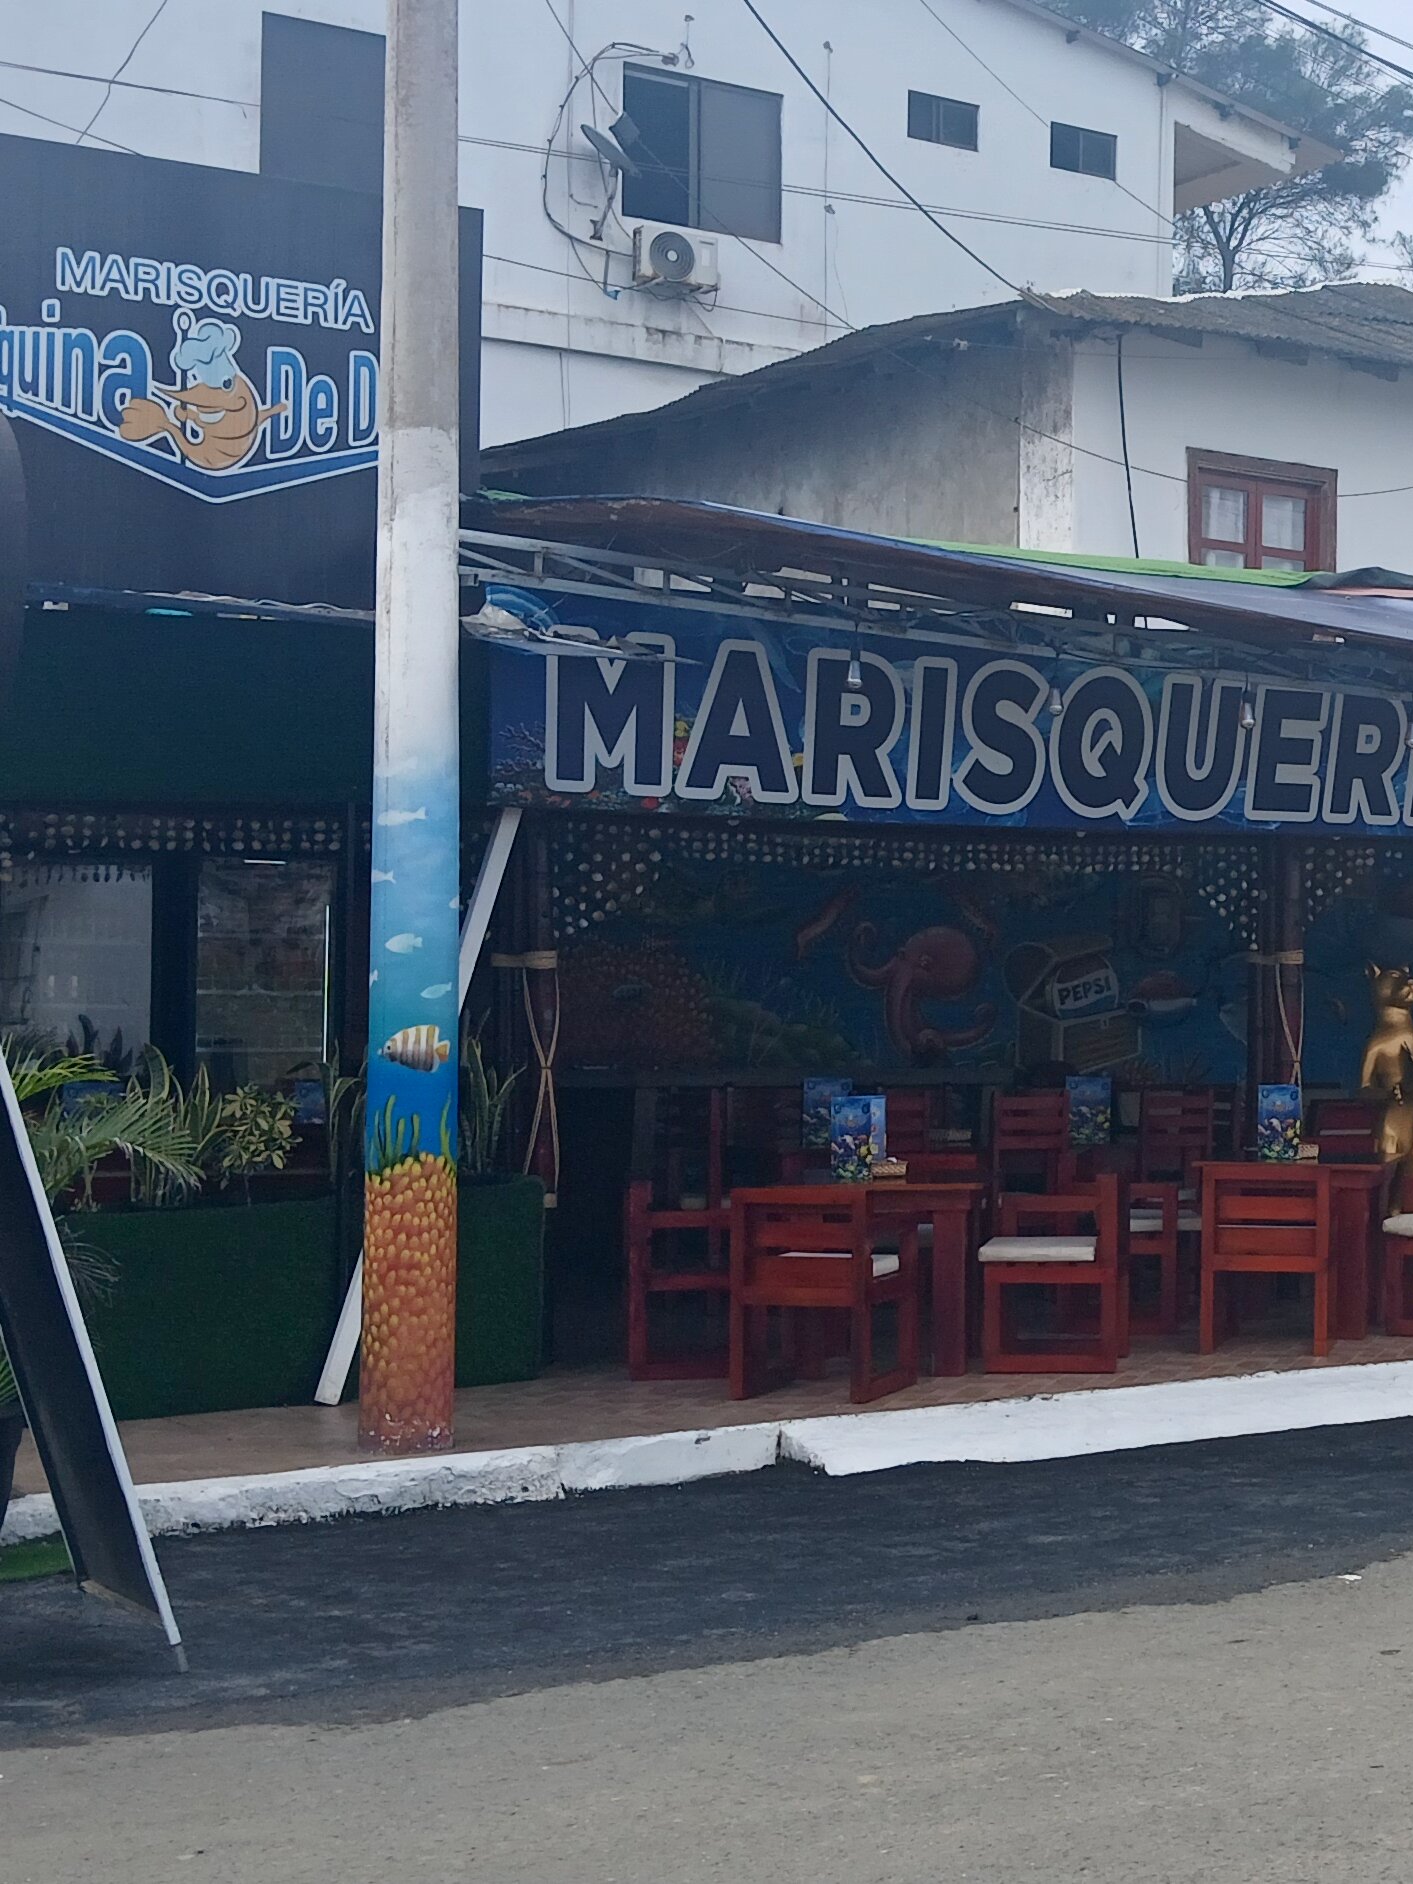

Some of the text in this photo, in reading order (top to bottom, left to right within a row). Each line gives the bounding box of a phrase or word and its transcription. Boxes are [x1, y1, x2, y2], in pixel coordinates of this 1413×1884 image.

[56, 246, 375, 334] MARISQUERÍA
[266, 346, 338, 460] De
[1057, 975, 1113, 1006] PEPSI
